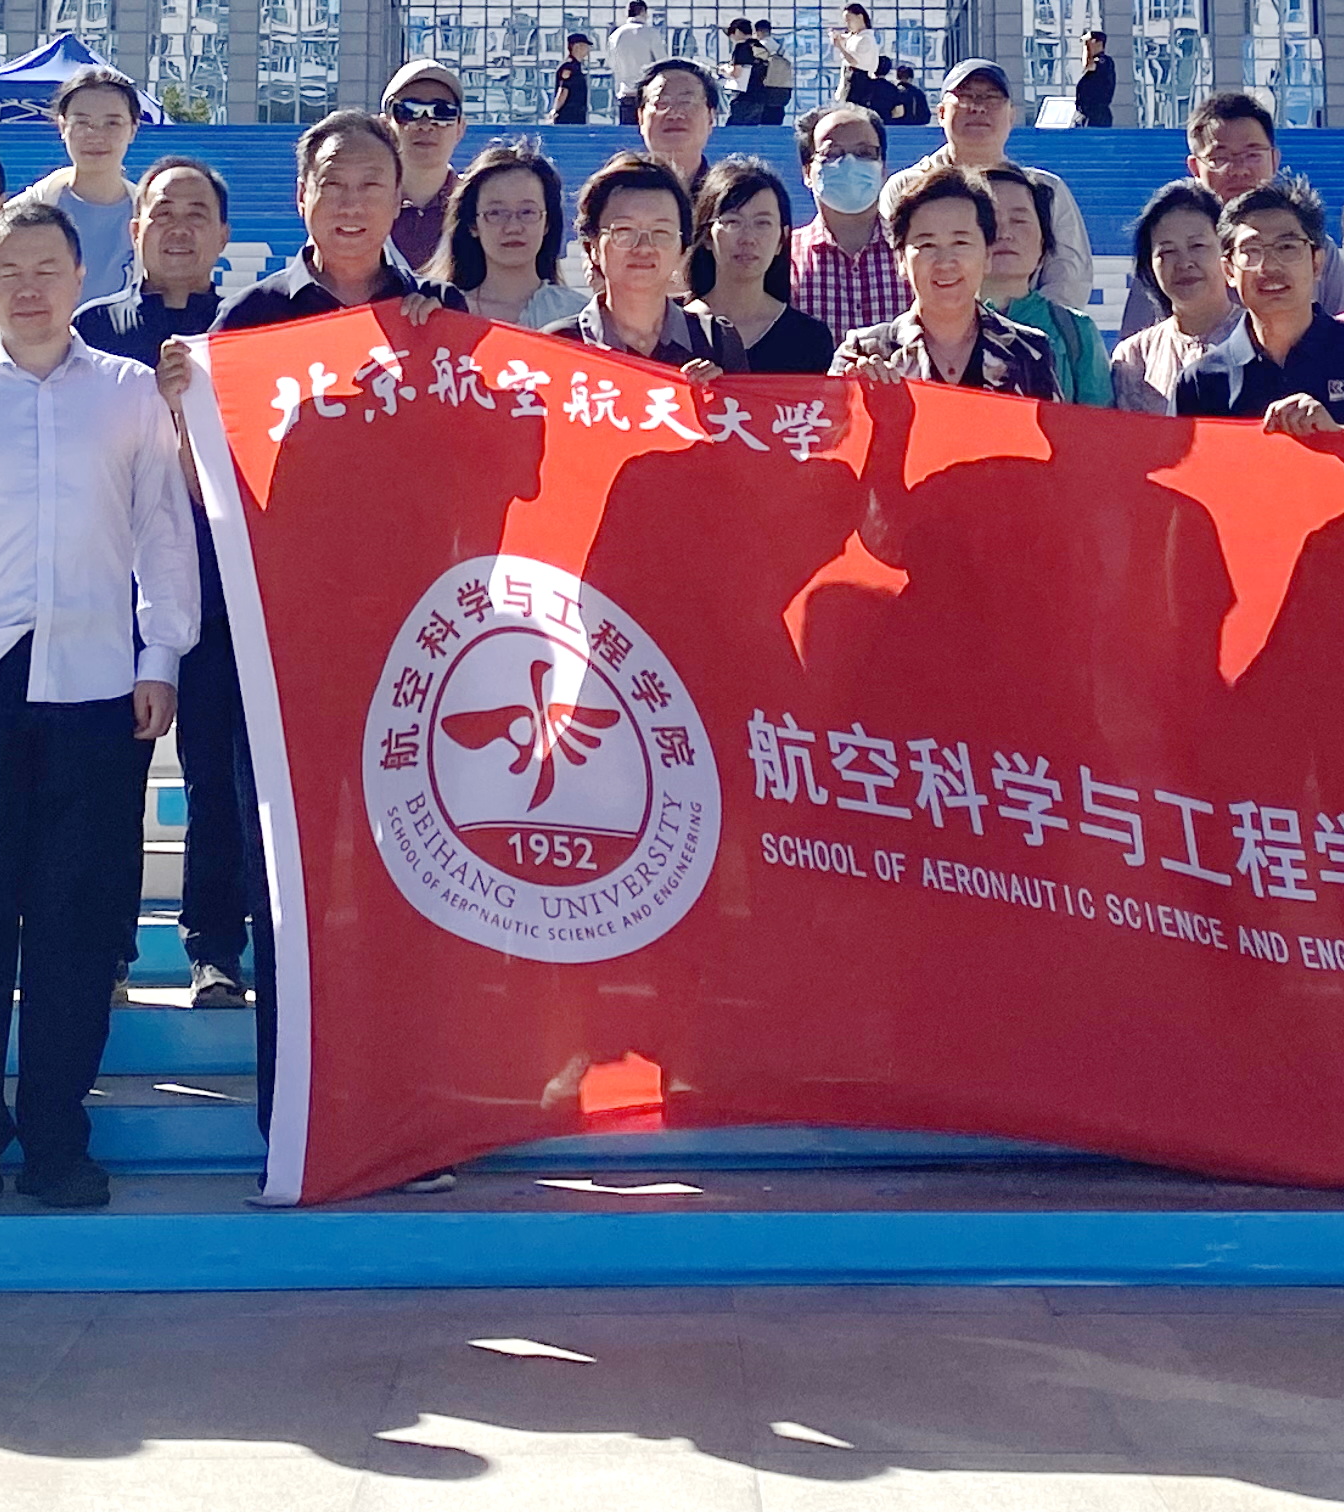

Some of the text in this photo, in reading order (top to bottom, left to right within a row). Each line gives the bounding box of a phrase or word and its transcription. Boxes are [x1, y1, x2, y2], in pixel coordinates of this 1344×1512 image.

[379, 574, 696, 772] 航空科学与工程学院
[386, 805, 422, 873] SCHOOL
[422, 870, 442, 890] OF
[547, 922, 618, 942] SCIENCE
[622, 905, 653, 931] AND
[653, 800, 704, 907] ENGINEERING
[405, 789, 683, 920] BEIHANG UNIVERSITY
[507, 832, 598, 872] 1952
[761, 832, 867, 878] SCHOOL
[873, 849, 906, 883] OF
[921, 857, 1095, 920] AERONAUTIC
[1105, 893, 1229, 951] SCIENCE
[1238, 924, 1289, 965] AND
